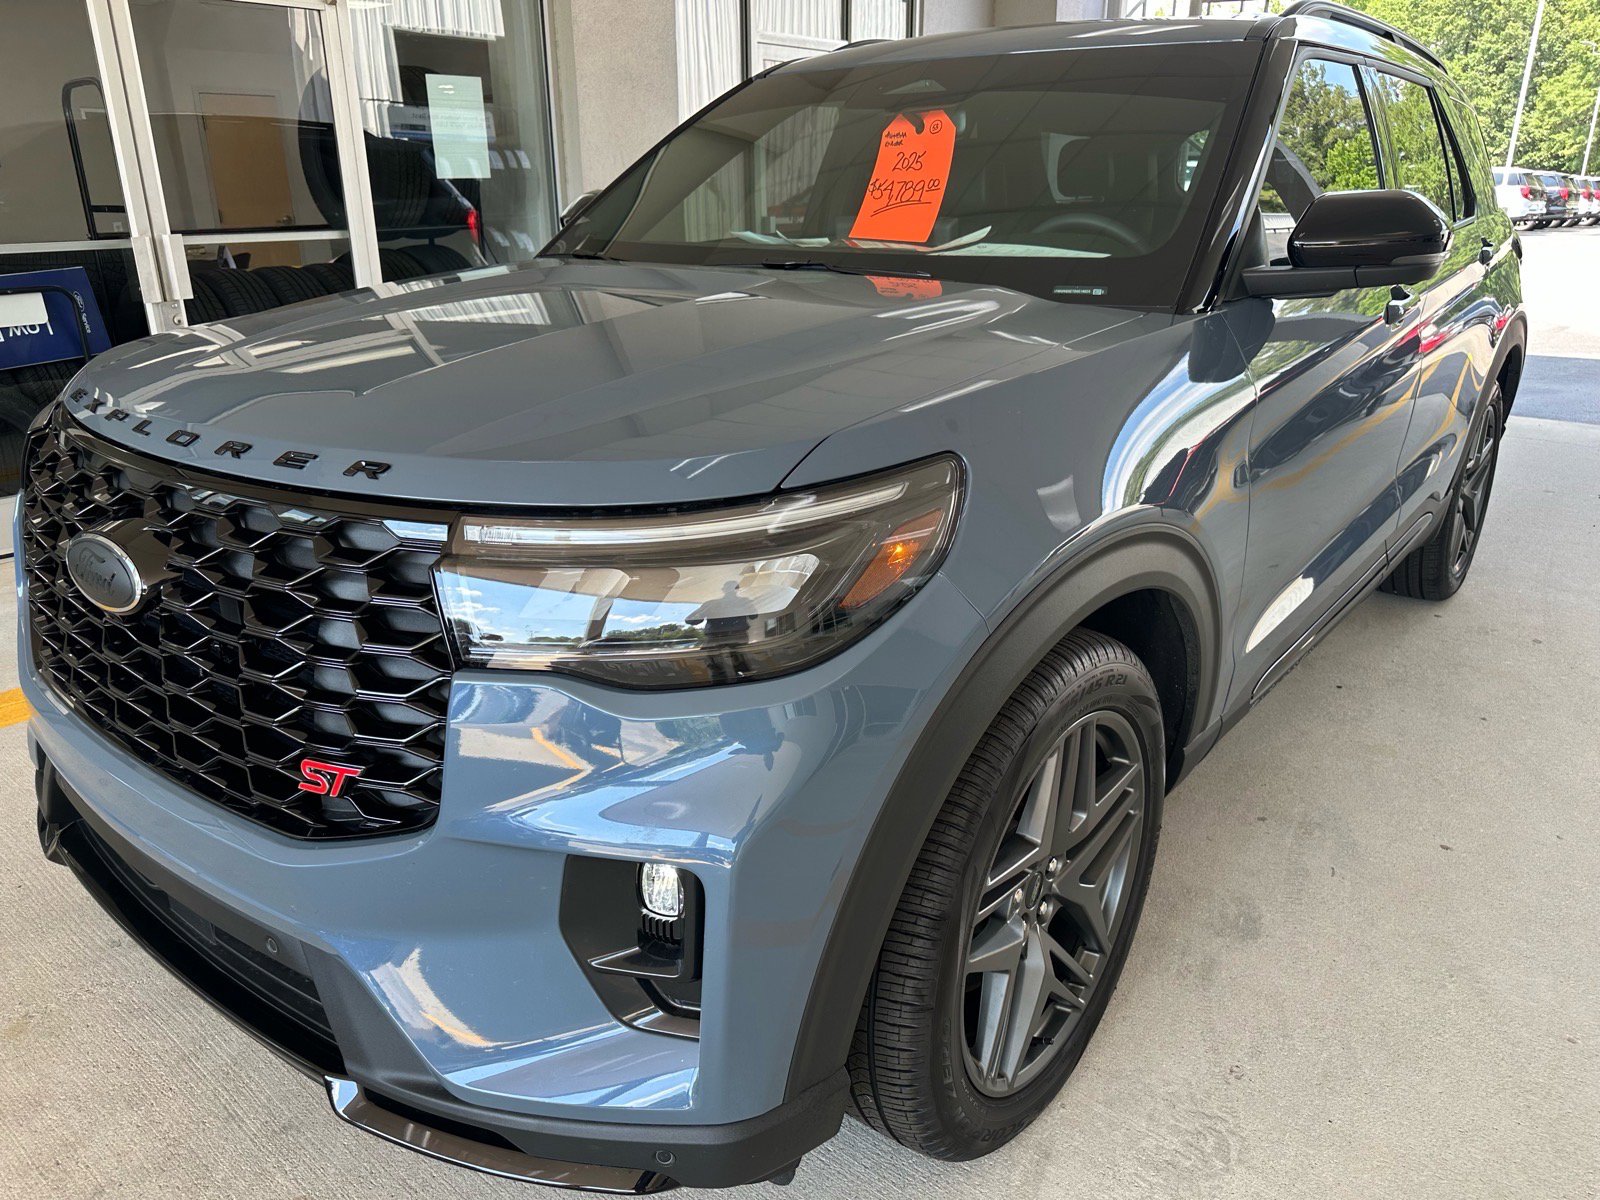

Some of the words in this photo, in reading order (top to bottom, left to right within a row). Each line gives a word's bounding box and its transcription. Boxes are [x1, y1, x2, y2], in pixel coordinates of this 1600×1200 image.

[892, 151, 926, 171] 2025
[70, 387, 391, 480] EXPLORER
[298, 758, 361, 798] ST
